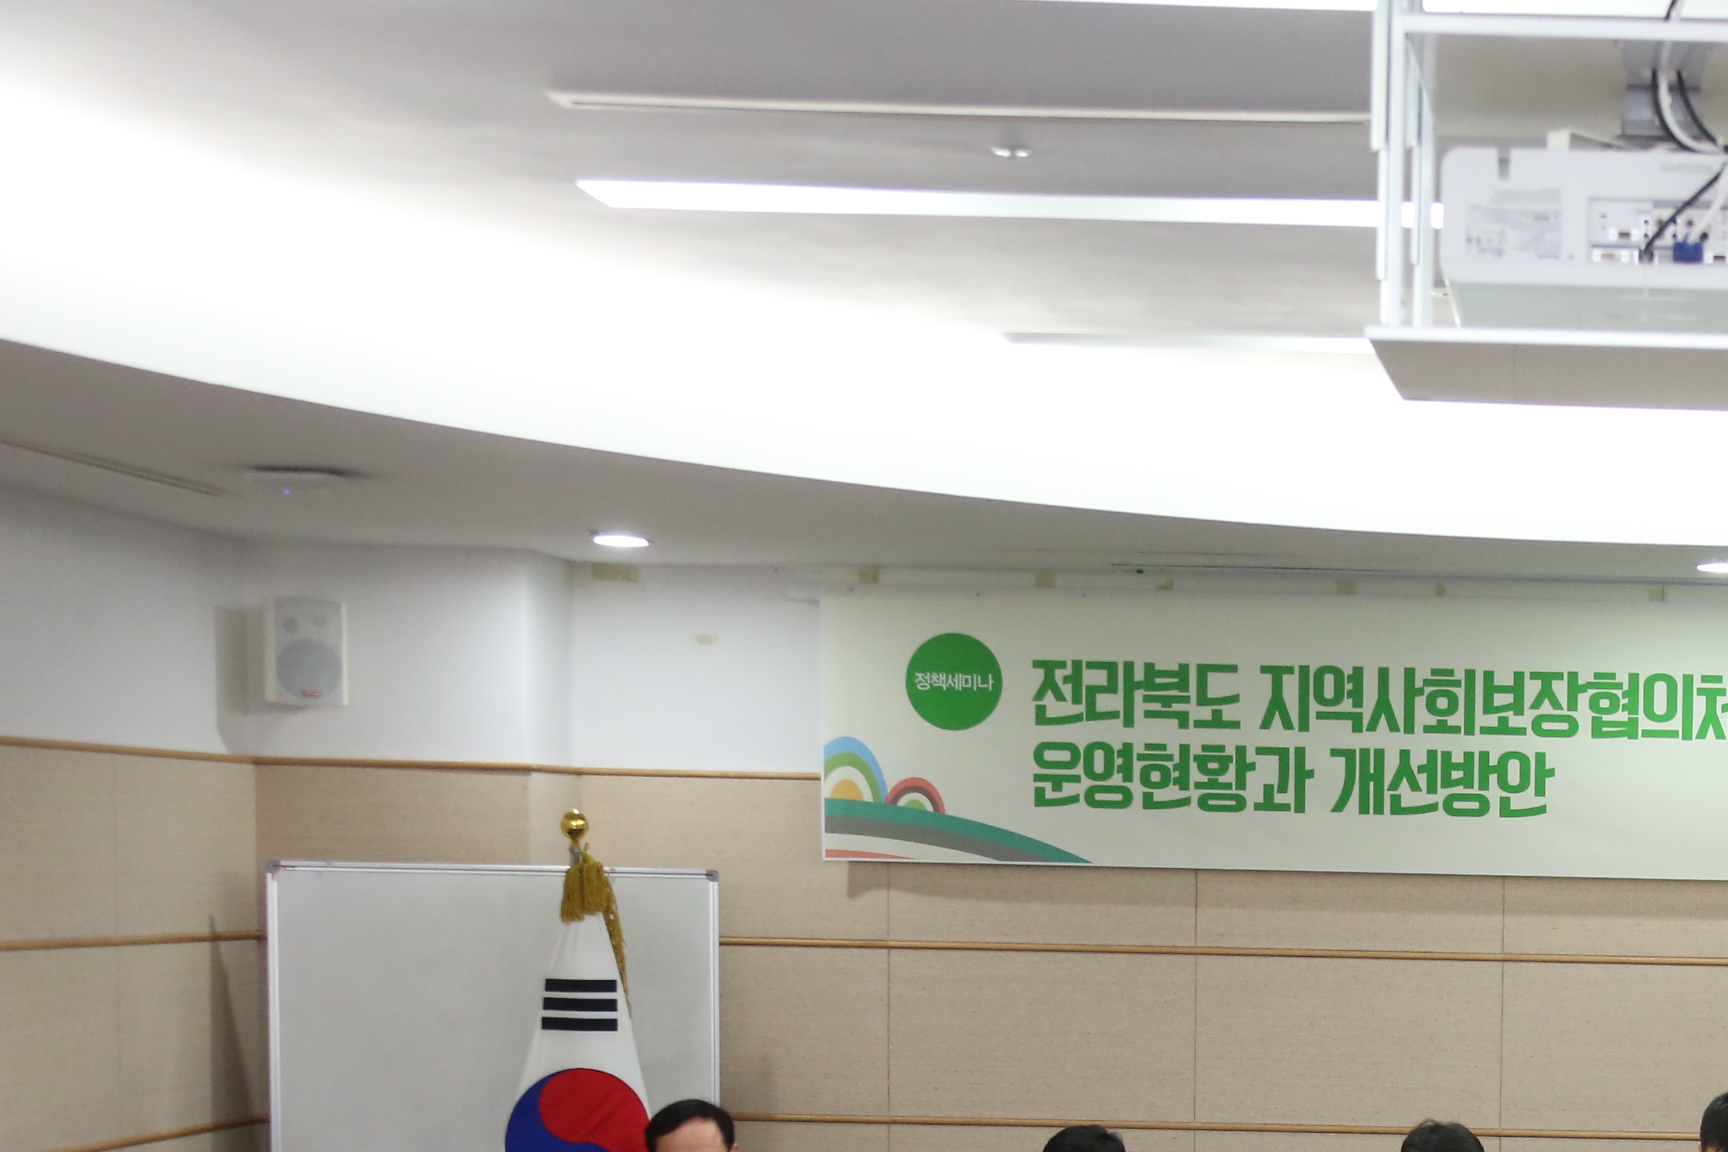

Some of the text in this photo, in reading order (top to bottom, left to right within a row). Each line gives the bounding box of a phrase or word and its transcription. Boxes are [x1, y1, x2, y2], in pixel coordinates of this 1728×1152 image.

[913, 670, 994, 693] 정책세미나
[1031, 658, 1241, 731] 전라북도
[1032, 740, 1556, 819] 운영현황과 개선방안
